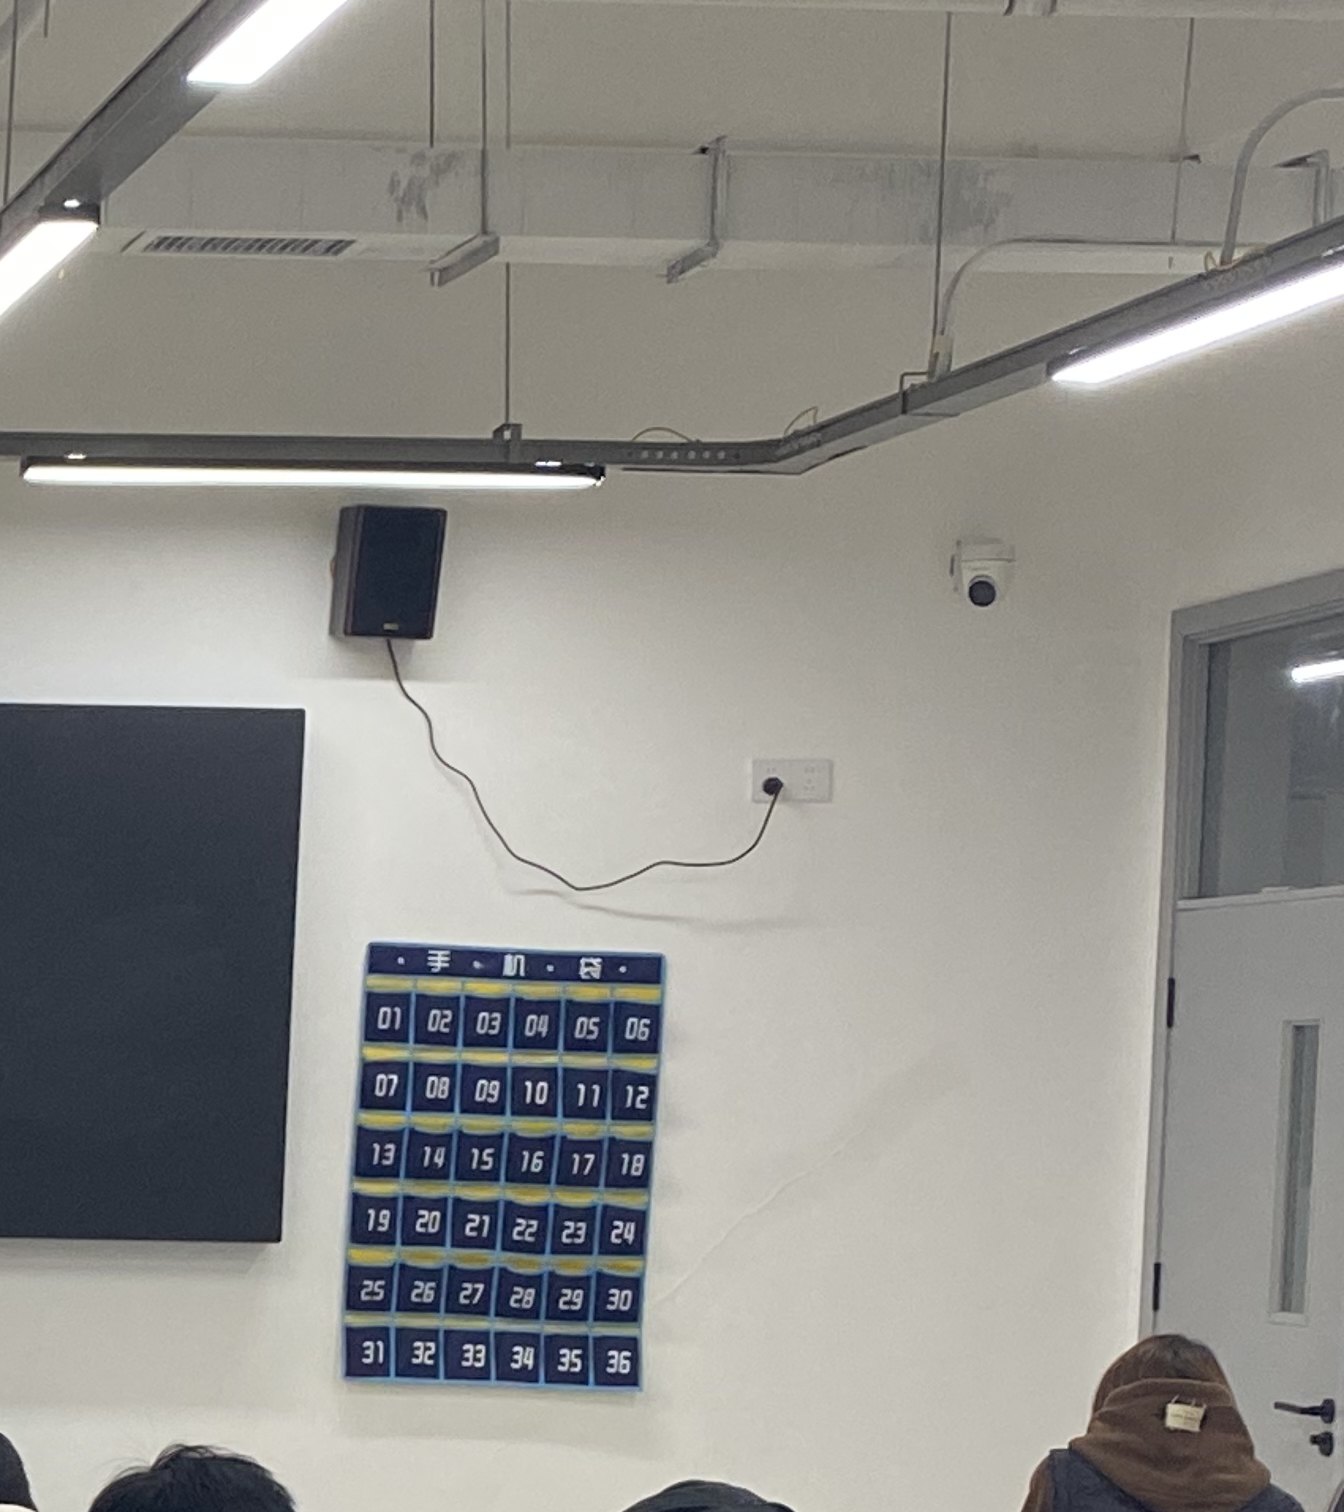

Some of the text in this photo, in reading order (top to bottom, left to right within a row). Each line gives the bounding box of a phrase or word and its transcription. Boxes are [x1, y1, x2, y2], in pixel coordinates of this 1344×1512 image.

[377, 1006, 651, 1041] 01 02 03 04 05 06
[374, 1073, 649, 1109] 07 08 09 10 11 12
[372, 1142, 645, 1176] 13 14 15 16 17 18
[367, 1208, 635, 1244] 19 20 21 22 23 24
[360, 1279, 633, 1311] 25 26 27 28 29 30
[361, 1340, 632, 1374] 31 32 33 34 35 36
